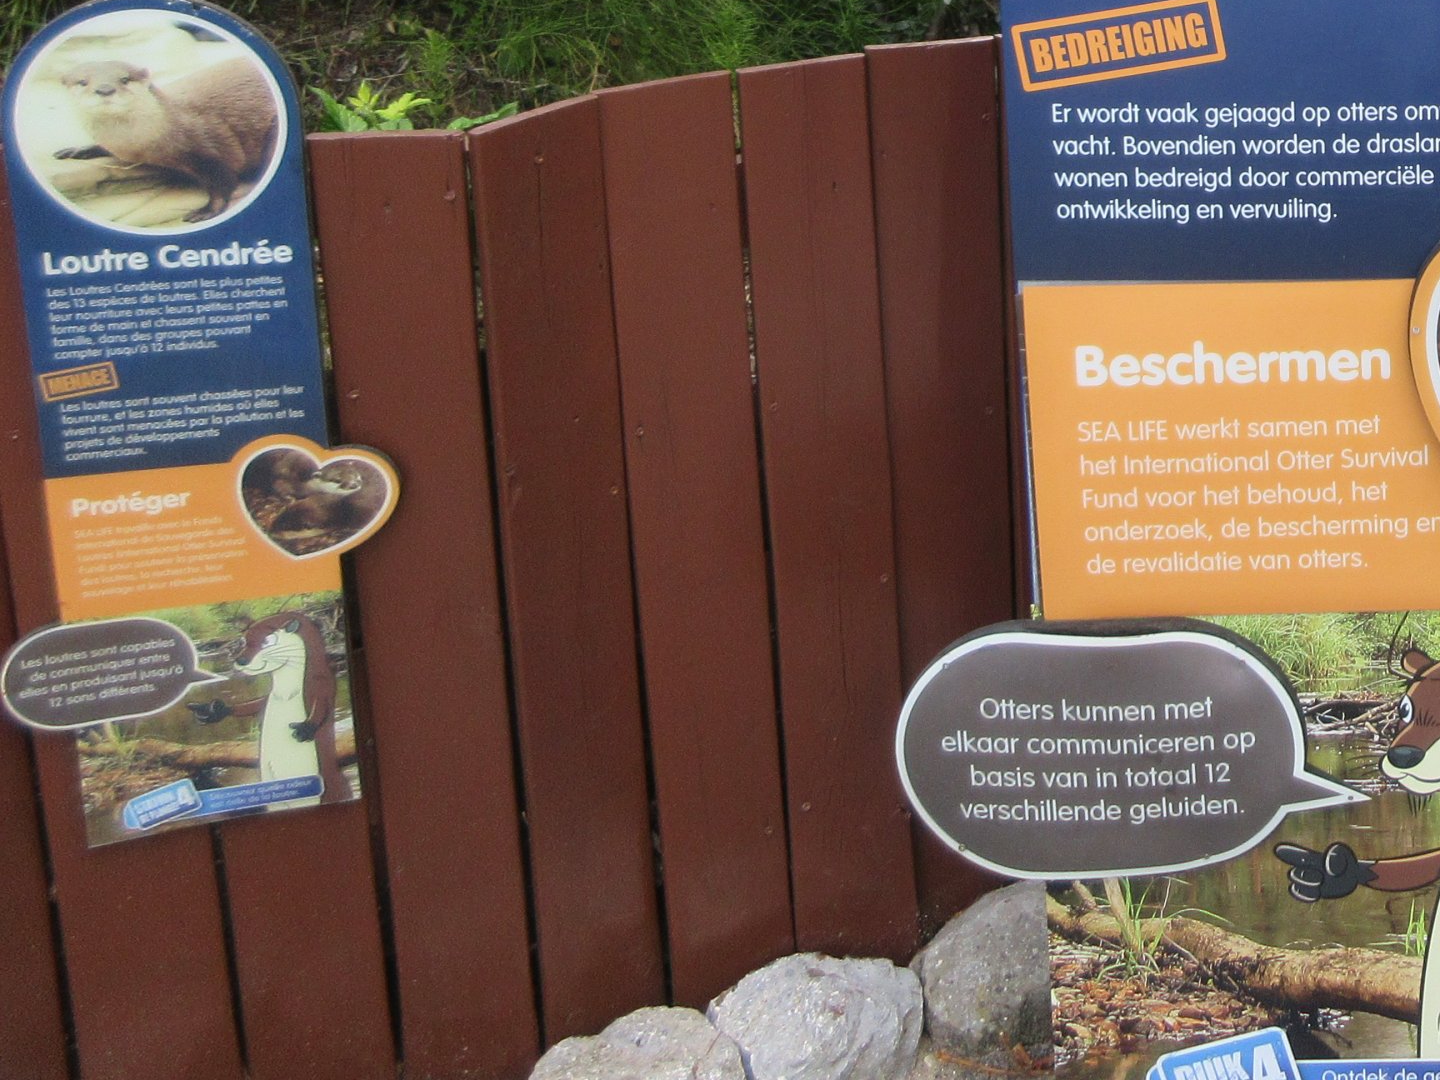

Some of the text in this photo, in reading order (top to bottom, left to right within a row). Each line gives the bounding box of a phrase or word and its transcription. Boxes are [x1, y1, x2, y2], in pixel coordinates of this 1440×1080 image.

[1030, 12, 1209, 74] BEDREIGING
[1051, 102, 1072, 123] Er
[1076, 102, 1141, 124] wordt
[1145, 101, 1199, 124] vaak
[1204, 100, 1295, 129] gejaagd
[1302, 106, 1331, 128] op
[1336, 102, 1398, 122] otters
[1052, 134, 1116, 156] vacht.
[1123, 134, 1236, 156] Bovendien
[1241, 133, 1326, 155] worden
[1332, 132, 1361, 154] de
[1053, 163, 1435, 193] wonen bedreigd door commerciële
[1056, 197, 1338, 225] ontwikkeling en vervuiling.
[42, 239, 293, 276] Loutre Cendrée
[1075, 341, 1391, 388] Beschermen
[1077, 414, 1381, 443] SEA LIFE werkt samen met
[1079, 444, 1429, 476] het International Otter Survival
[70, 489, 191, 519] Protéger
[1081, 480, 1389, 509] Fund voor het behoud, het
[1083, 517, 1213, 543] onderzoek,
[1220, 517, 1251, 540] de
[1257, 513, 1409, 540] bescherming
[1086, 549, 1368, 576] de revalidatie van otters.
[979, 696, 1213, 722] Otters kunnen met
[941, 729, 1256, 755] elkaar communiceren op
[970, 762, 1231, 789] basis van in totaal 12
[959, 794, 1245, 824] verschillende geluiden.
[1252, 1043, 1287, 1080] 4
[1322, 1068, 1388, 1080] Ontdek
[1394, 1068, 1417, 1080] de
